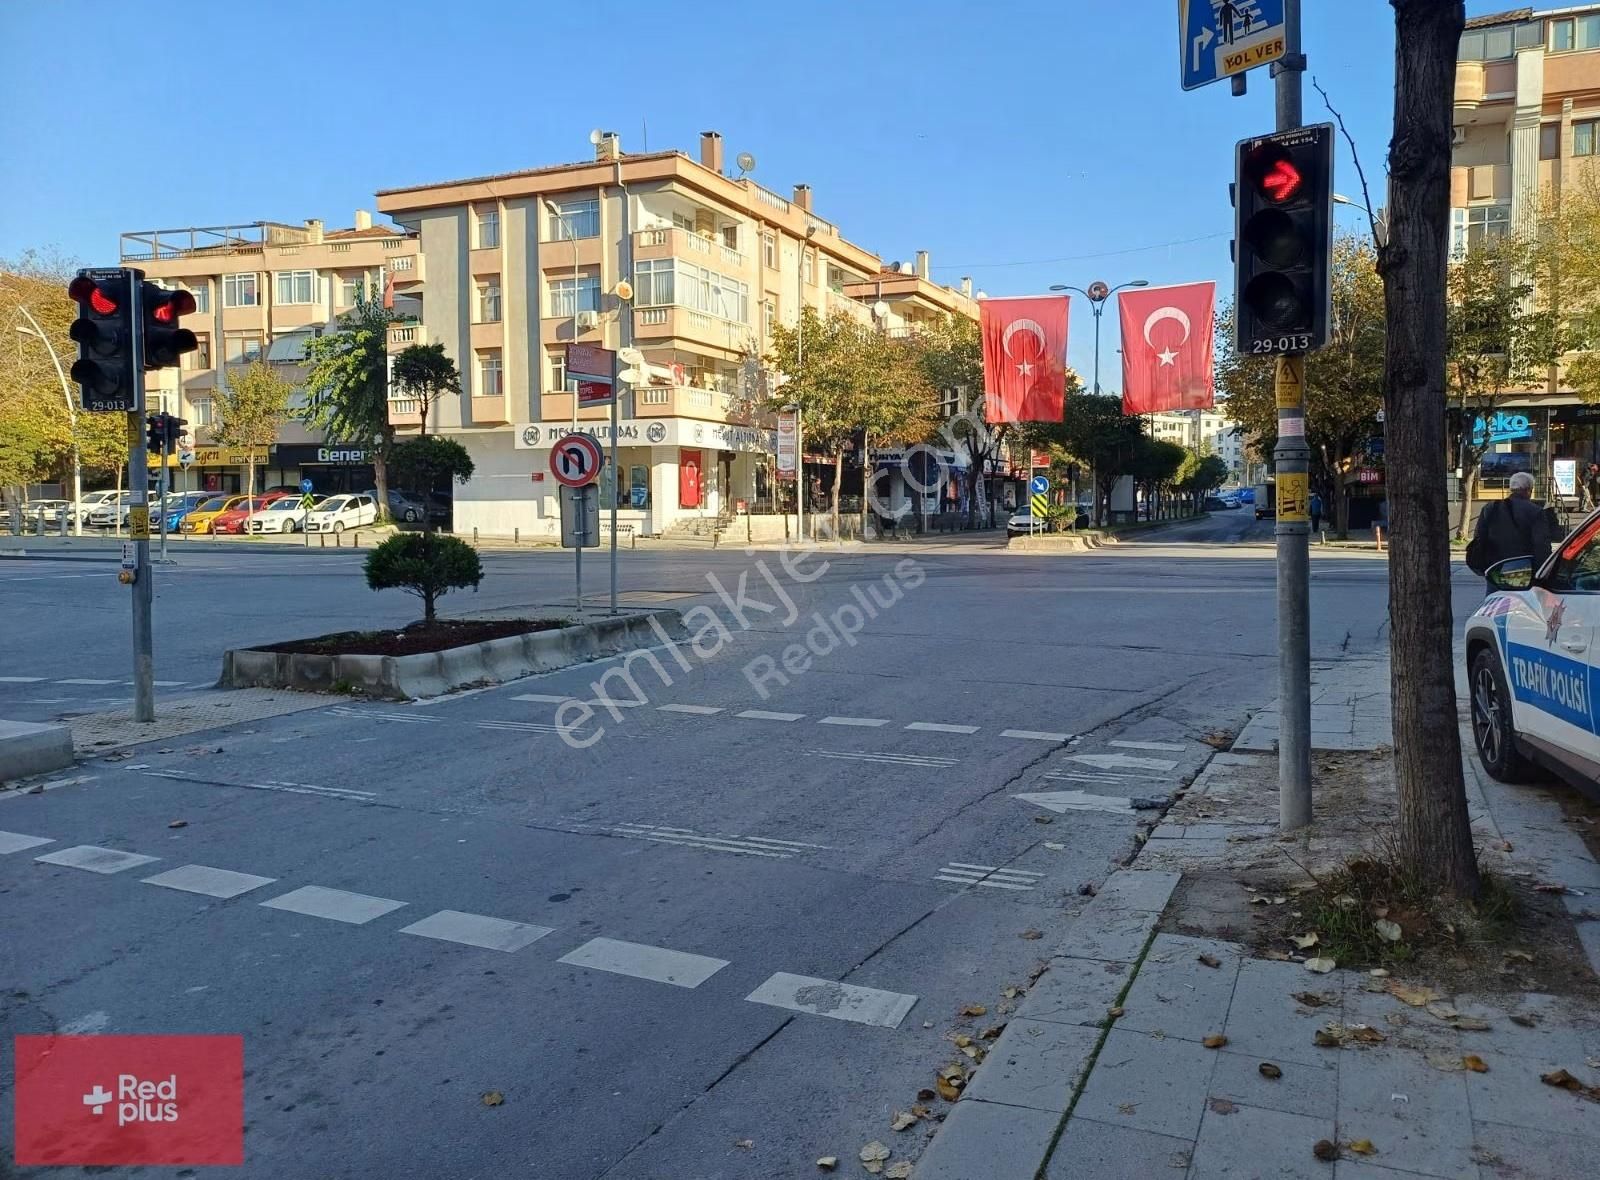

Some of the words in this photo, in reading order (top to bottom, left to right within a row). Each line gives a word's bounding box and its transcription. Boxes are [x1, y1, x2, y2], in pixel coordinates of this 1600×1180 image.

[1225, 52, 1251, 69] YOL
[1256, 40, 1282, 58] VER
[1253, 335, 1309, 353] 29-013
[92, 401, 125, 411] 29-013
[318, 448, 367, 461] Gener
[1361, 470, 1378, 481] BİM
[1513, 656, 1550, 698] TRAFİK
[1551, 669, 1587, 714] POLİSİ
